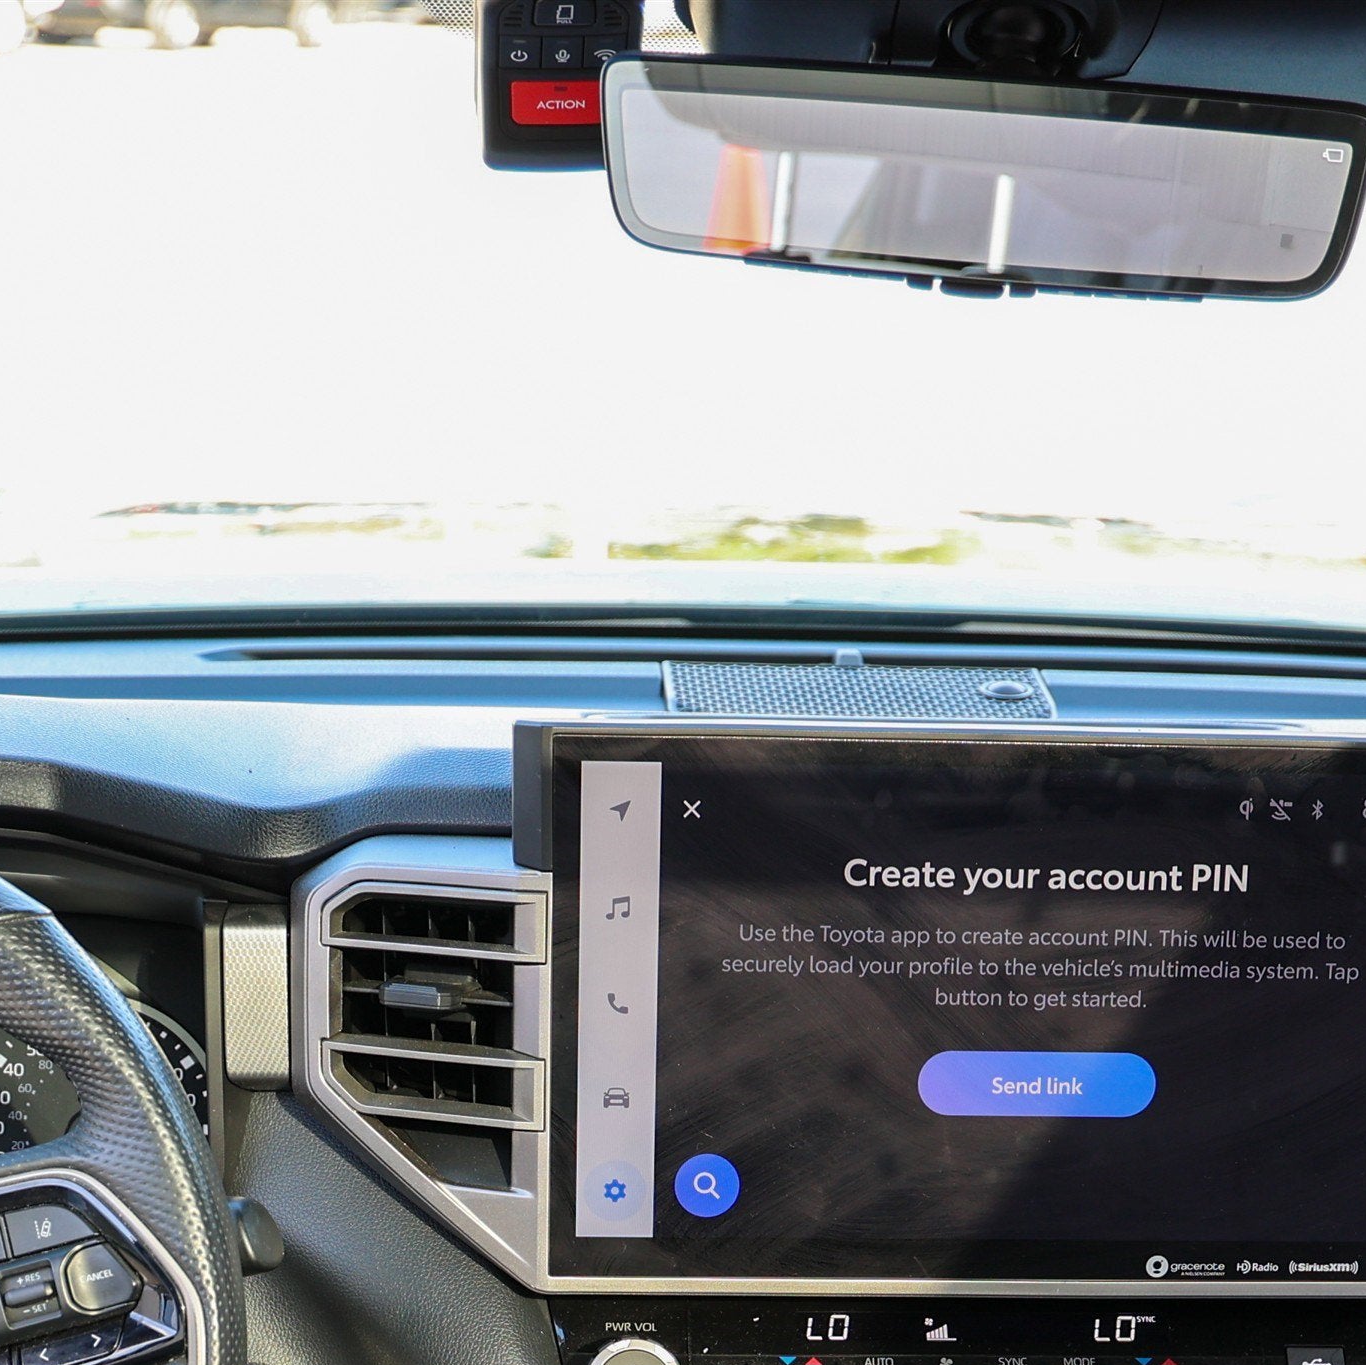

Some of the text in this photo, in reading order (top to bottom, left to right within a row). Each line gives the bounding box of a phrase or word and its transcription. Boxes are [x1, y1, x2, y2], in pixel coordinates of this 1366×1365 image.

[536, 100, 586, 110] ACTION
[843, 858, 1248, 895] Create your account PIN
[739, 924, 1345, 950] Use the Toyota app to create account PIN. This will be used to
[721, 955, 804, 977] securely
[809, 956, 853, 973] load
[858, 959, 903, 977] your
[909, 957, 973, 978] profile
[979, 959, 998, 976] to
[1004, 957, 1036, 976] the
[1128, 960, 1240, 978] multimedia
[1246, 964, 1318, 983] system.
[1325, 963, 1359, 984] Tap
[935, 988, 1147, 1010] button to get started.
[3, 1063, 24, 1076] 40
[38, 1060, 52, 1070] 80
[17, 1083, 32, 1093] 60
[992, 1077, 1083, 1095] Send link
[8, 1110, 23, 1120] 40
[11, 1141, 25, 1150] 20
[1170, 1263, 1225, 1273] gracenote
[1252, 1262, 1279, 1272] Radio
[80, 1268, 114, 1283] CANCEL
[605, 1321, 657, 1332] PWR VOL
[806, 1314, 850, 1341] LO
[1094, 1315, 1136, 1342] LO
